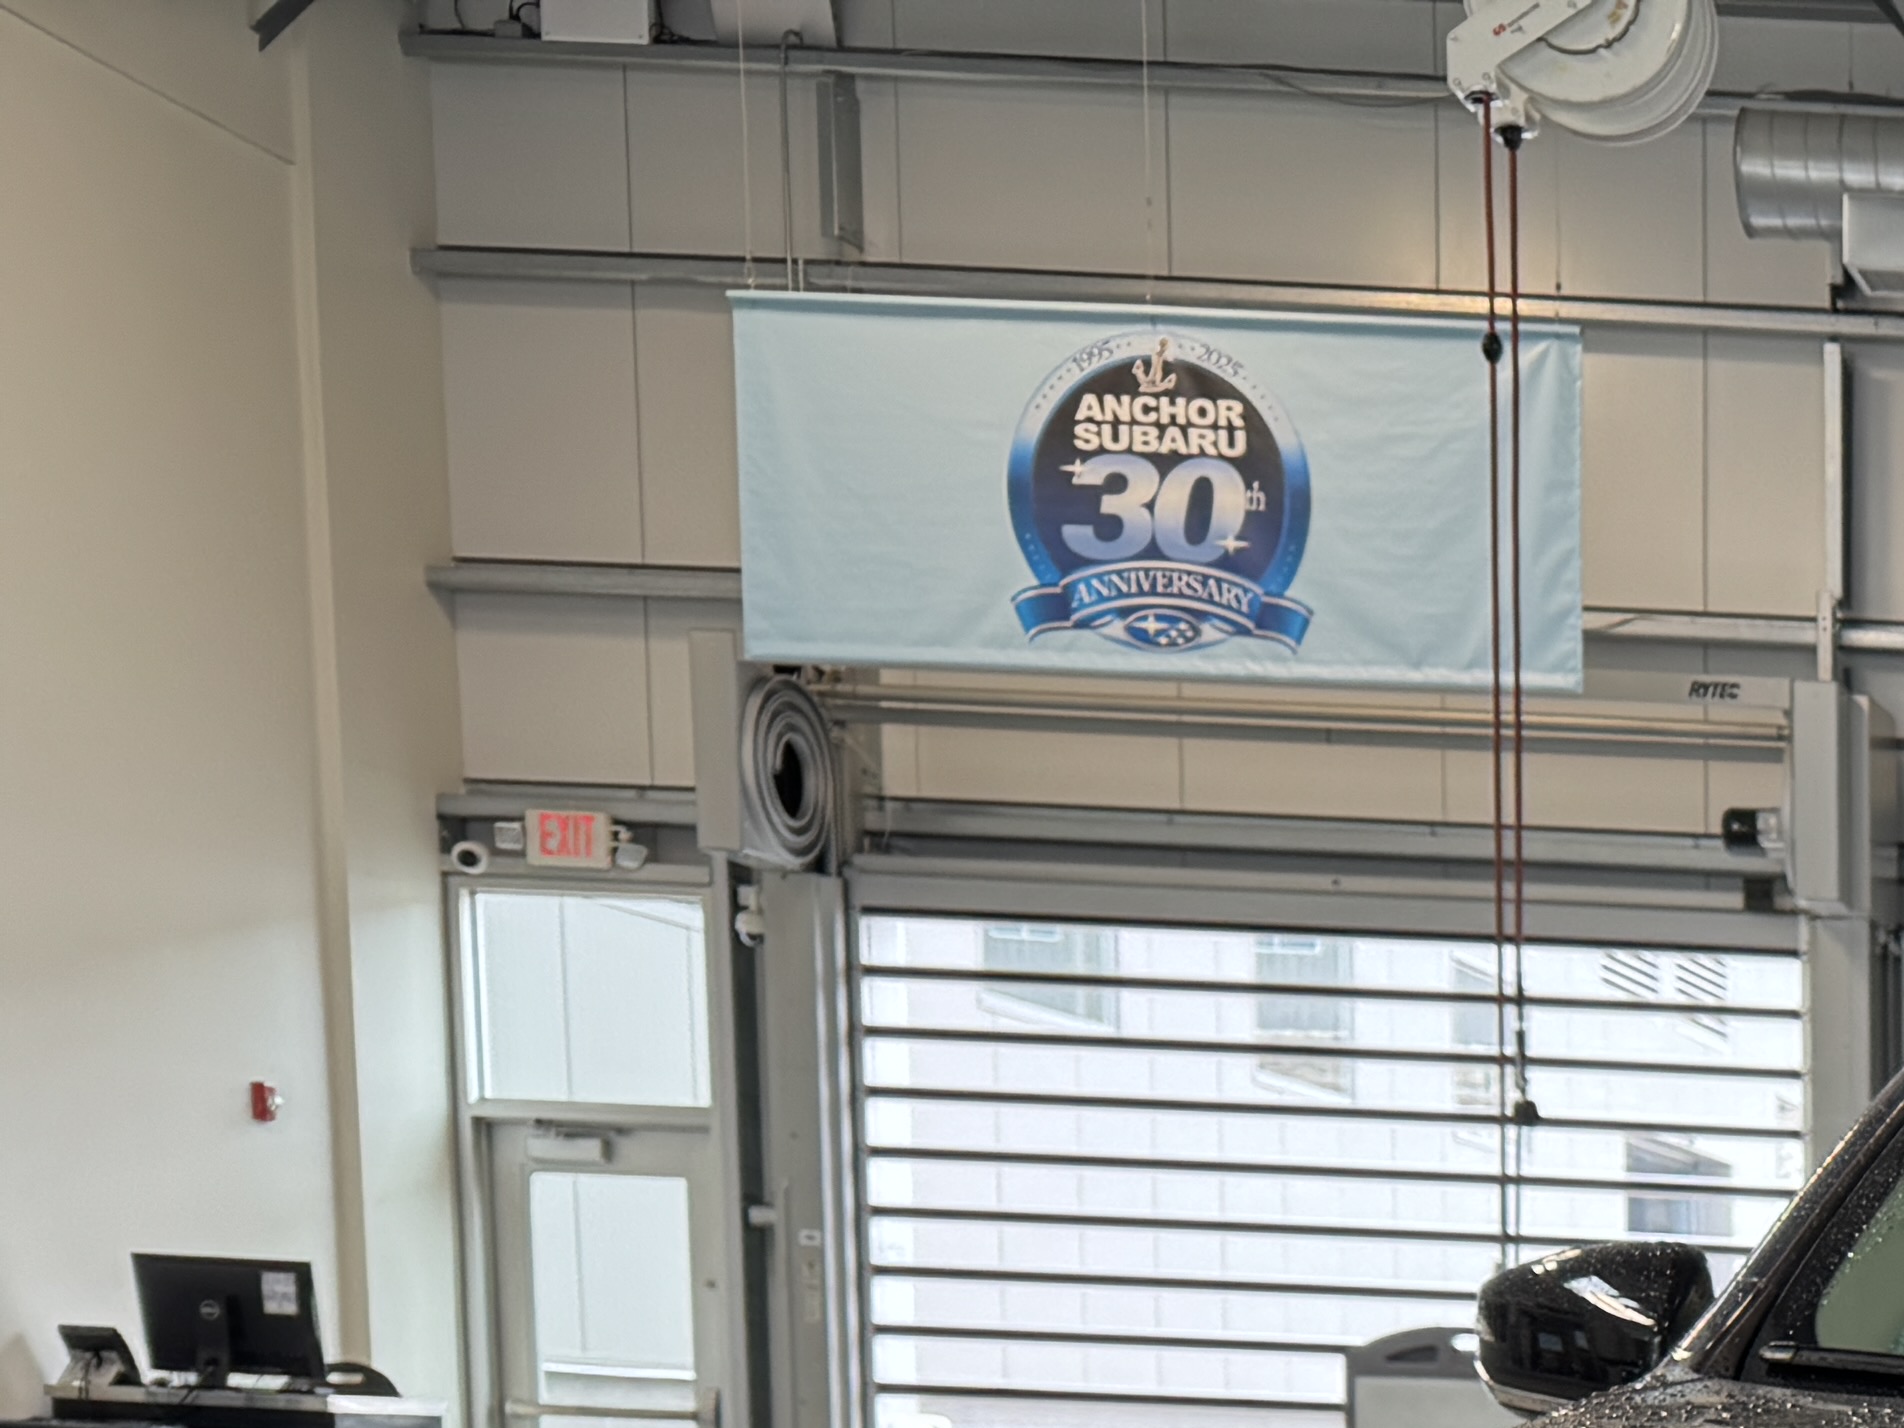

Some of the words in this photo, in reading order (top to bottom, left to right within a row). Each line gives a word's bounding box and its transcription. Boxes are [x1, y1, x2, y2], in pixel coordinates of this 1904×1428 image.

[1072, 339, 1115, 374] 1995
[1197, 343, 1245, 378] 2025
[1074, 393, 1246, 428] ANCHOR
[1073, 422, 1248, 459] SUBARU
[1071, 569, 1254, 615] ANNIVERSARY
[539, 811, 596, 858] EXIT
